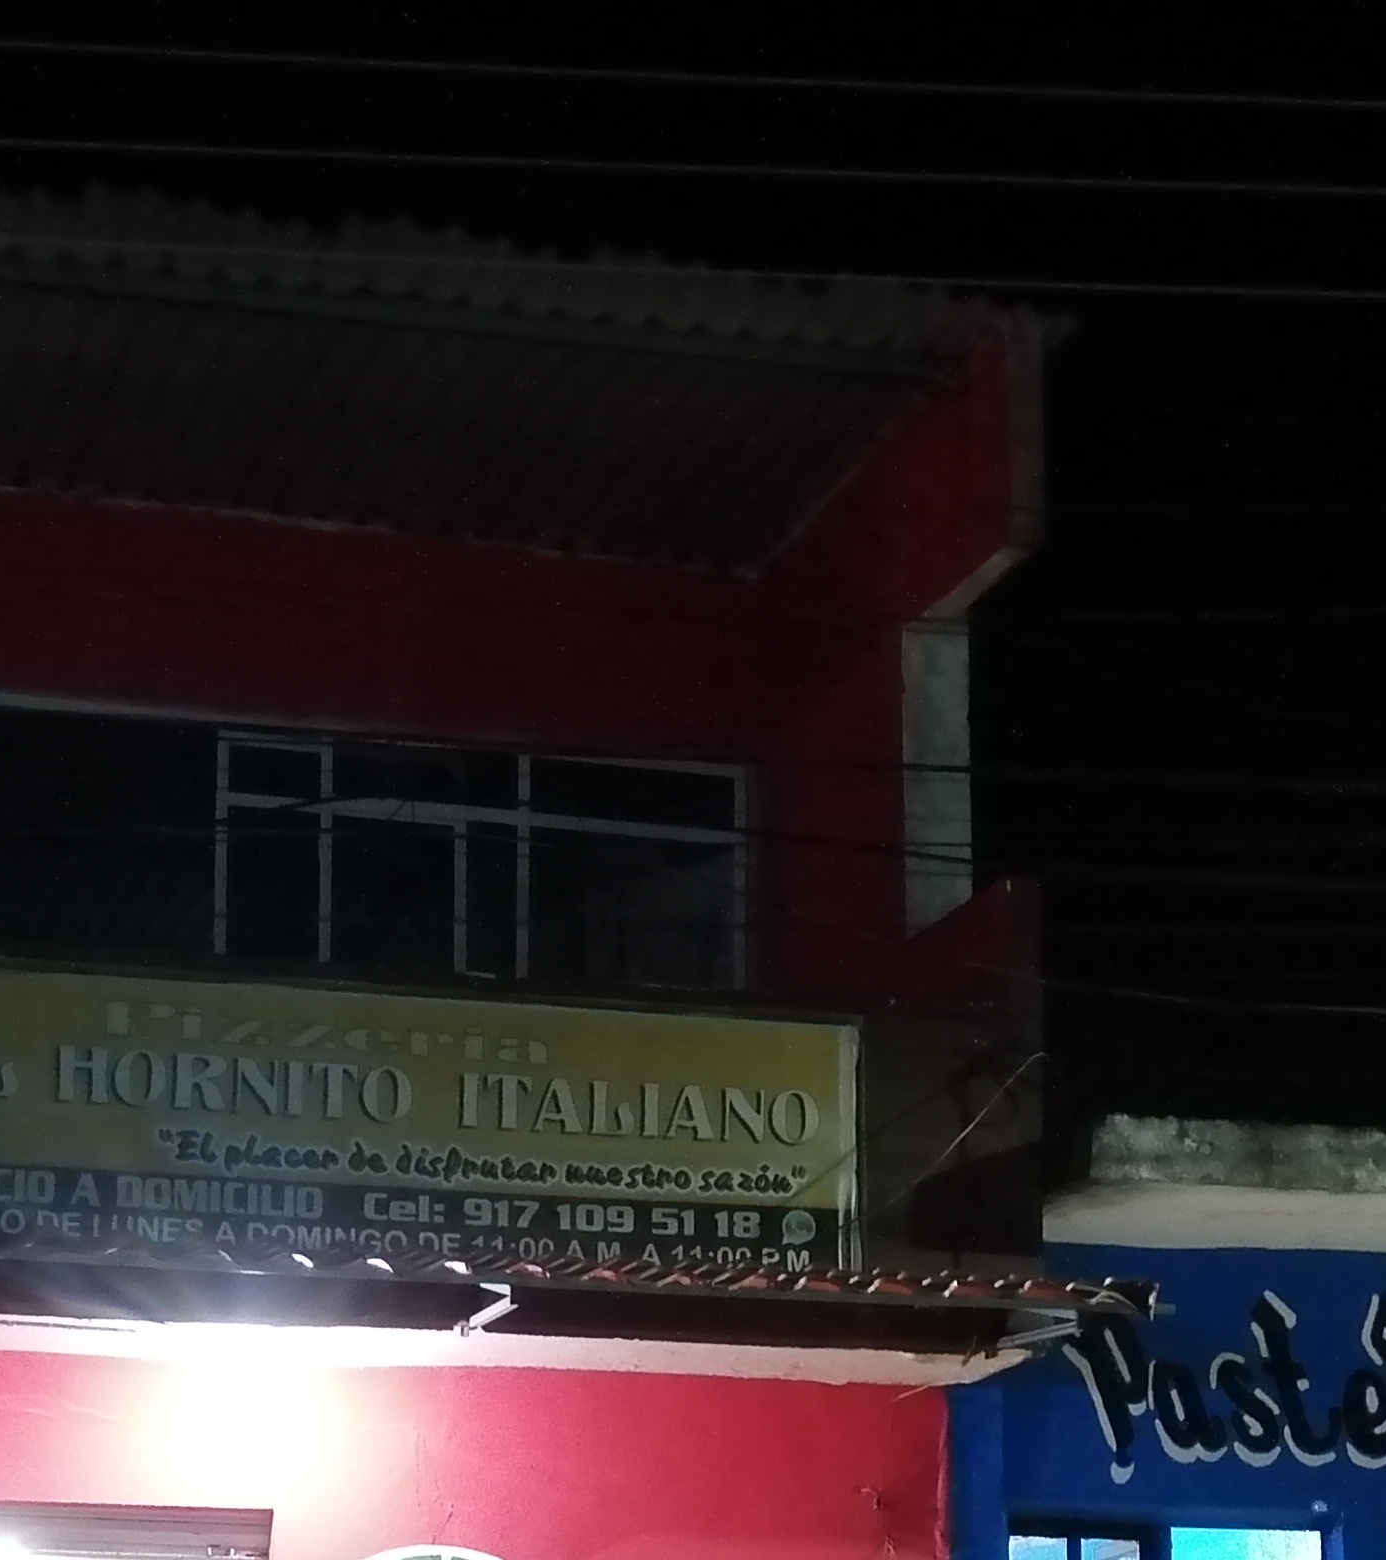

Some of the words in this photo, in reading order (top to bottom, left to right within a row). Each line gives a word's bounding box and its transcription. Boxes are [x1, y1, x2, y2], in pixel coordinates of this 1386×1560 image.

[106, 1000, 549, 1064] Pizzeria
[56, 1043, 413, 1124] HORNITO
[458, 1070, 821, 1147] ITALIANO
[224, 1133, 341, 1173] placer
[347, 1141, 389, 1174] de
[564, 1161, 693, 1191] nuestro
[70, 1172, 103, 1208] A
[115, 1174, 325, 1220] DOMICILIO
[363, 1191, 446, 1225] Cel:
[463, 1197, 541, 1229] 917
[556, 1203, 635, 1234] 109
[650, 1207, 696, 1237] 51
[713, 1210, 762, 1240] 18
[214, 1220, 237, 1247] A
